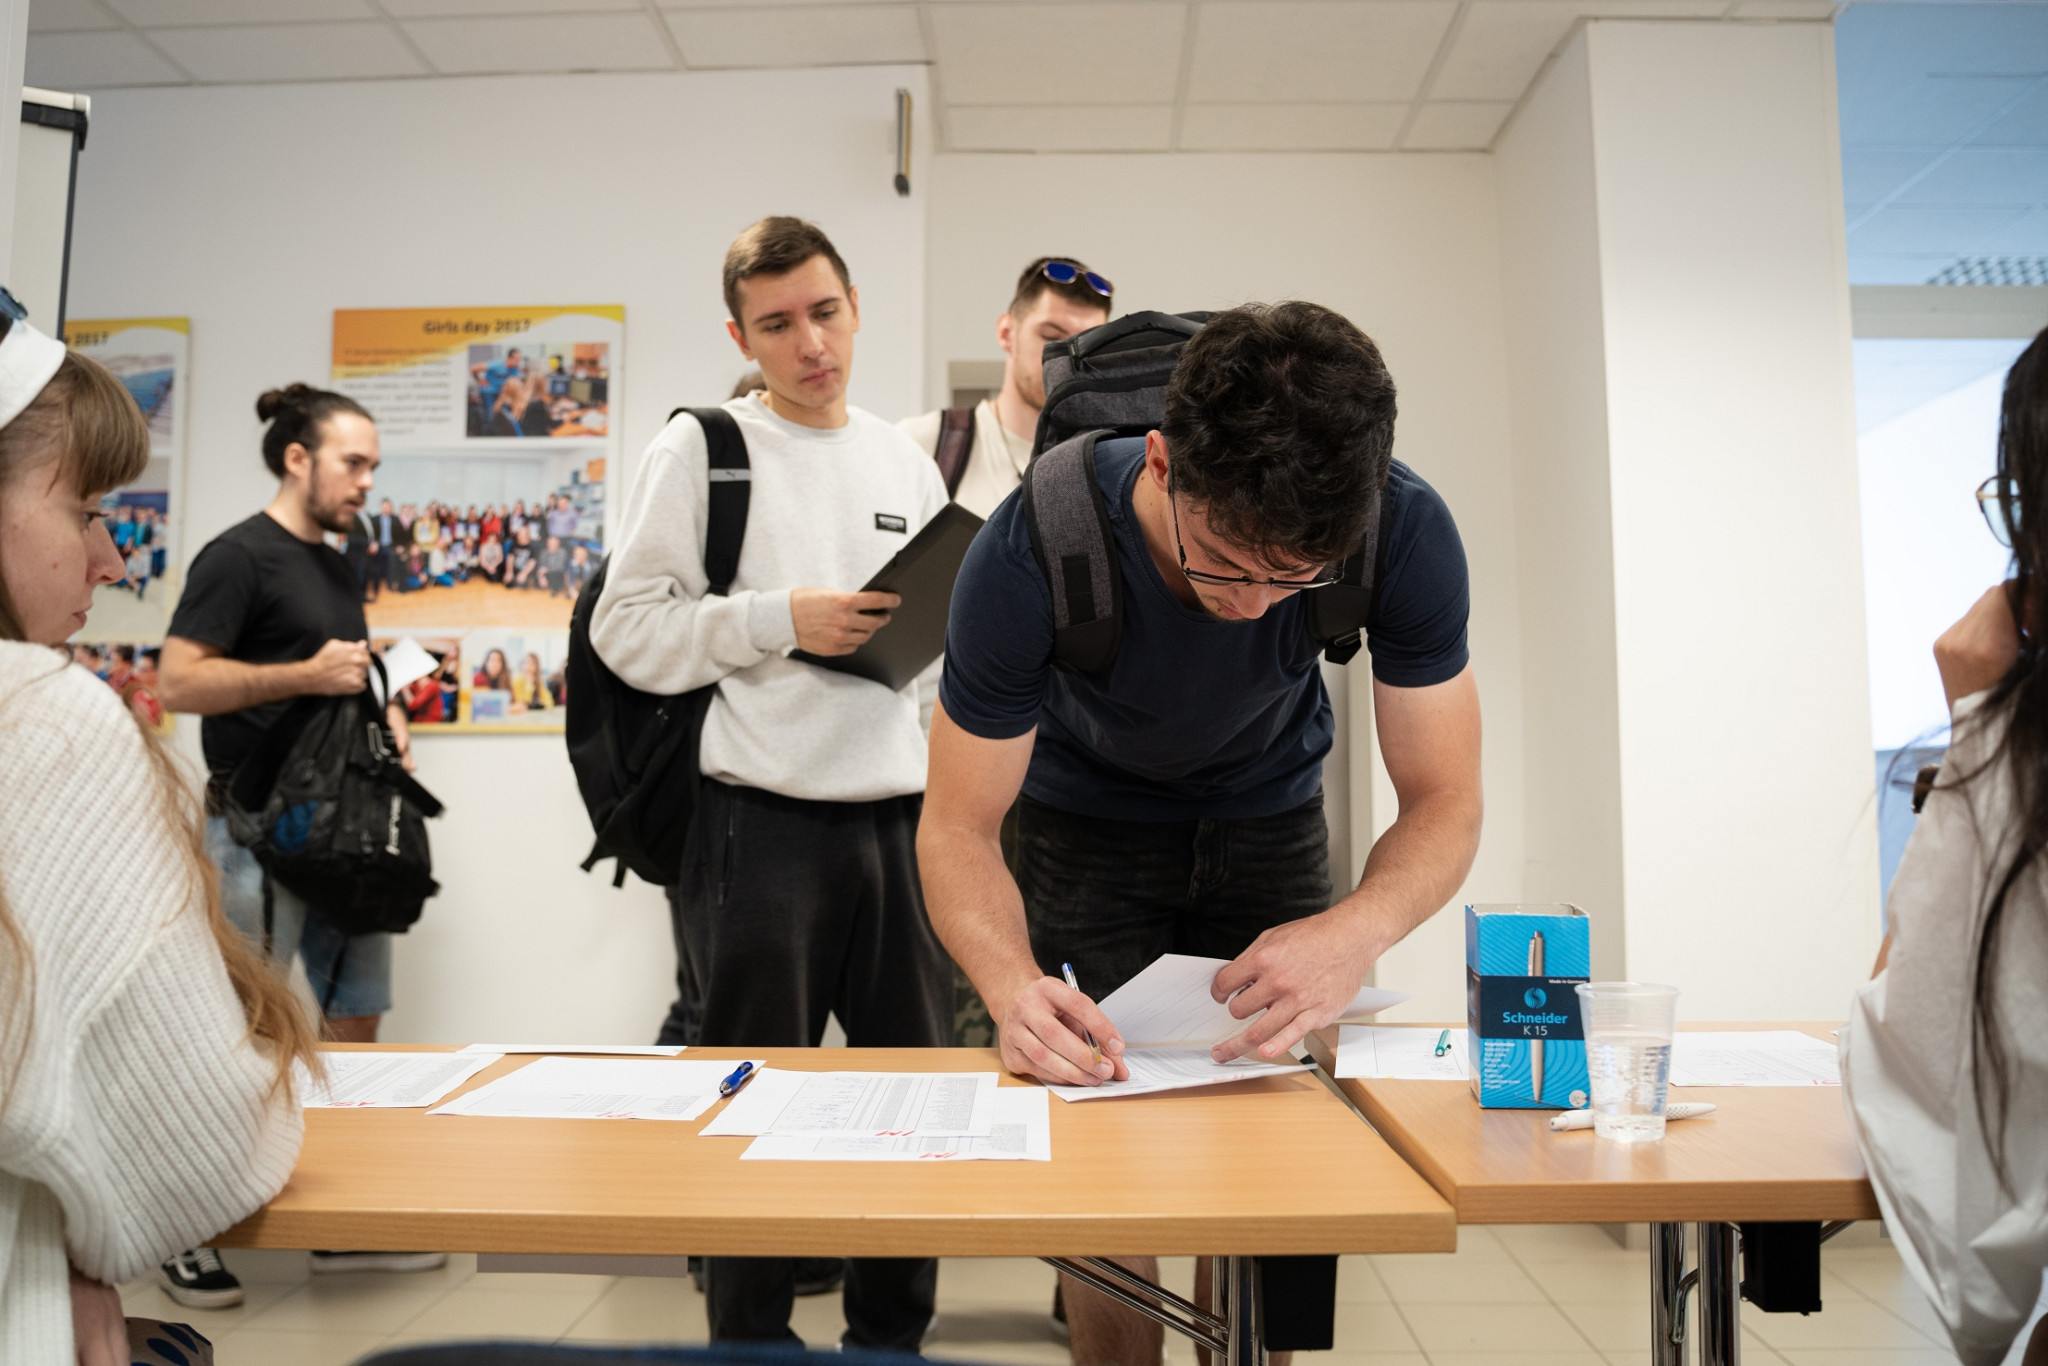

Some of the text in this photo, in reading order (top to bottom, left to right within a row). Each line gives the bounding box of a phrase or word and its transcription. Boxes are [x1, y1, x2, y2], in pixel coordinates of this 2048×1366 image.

[423, 318, 531, 336] Girls day 2017
[1502, 1011, 1568, 1024] Schneider
[1523, 1025, 1548, 1036] K 15
